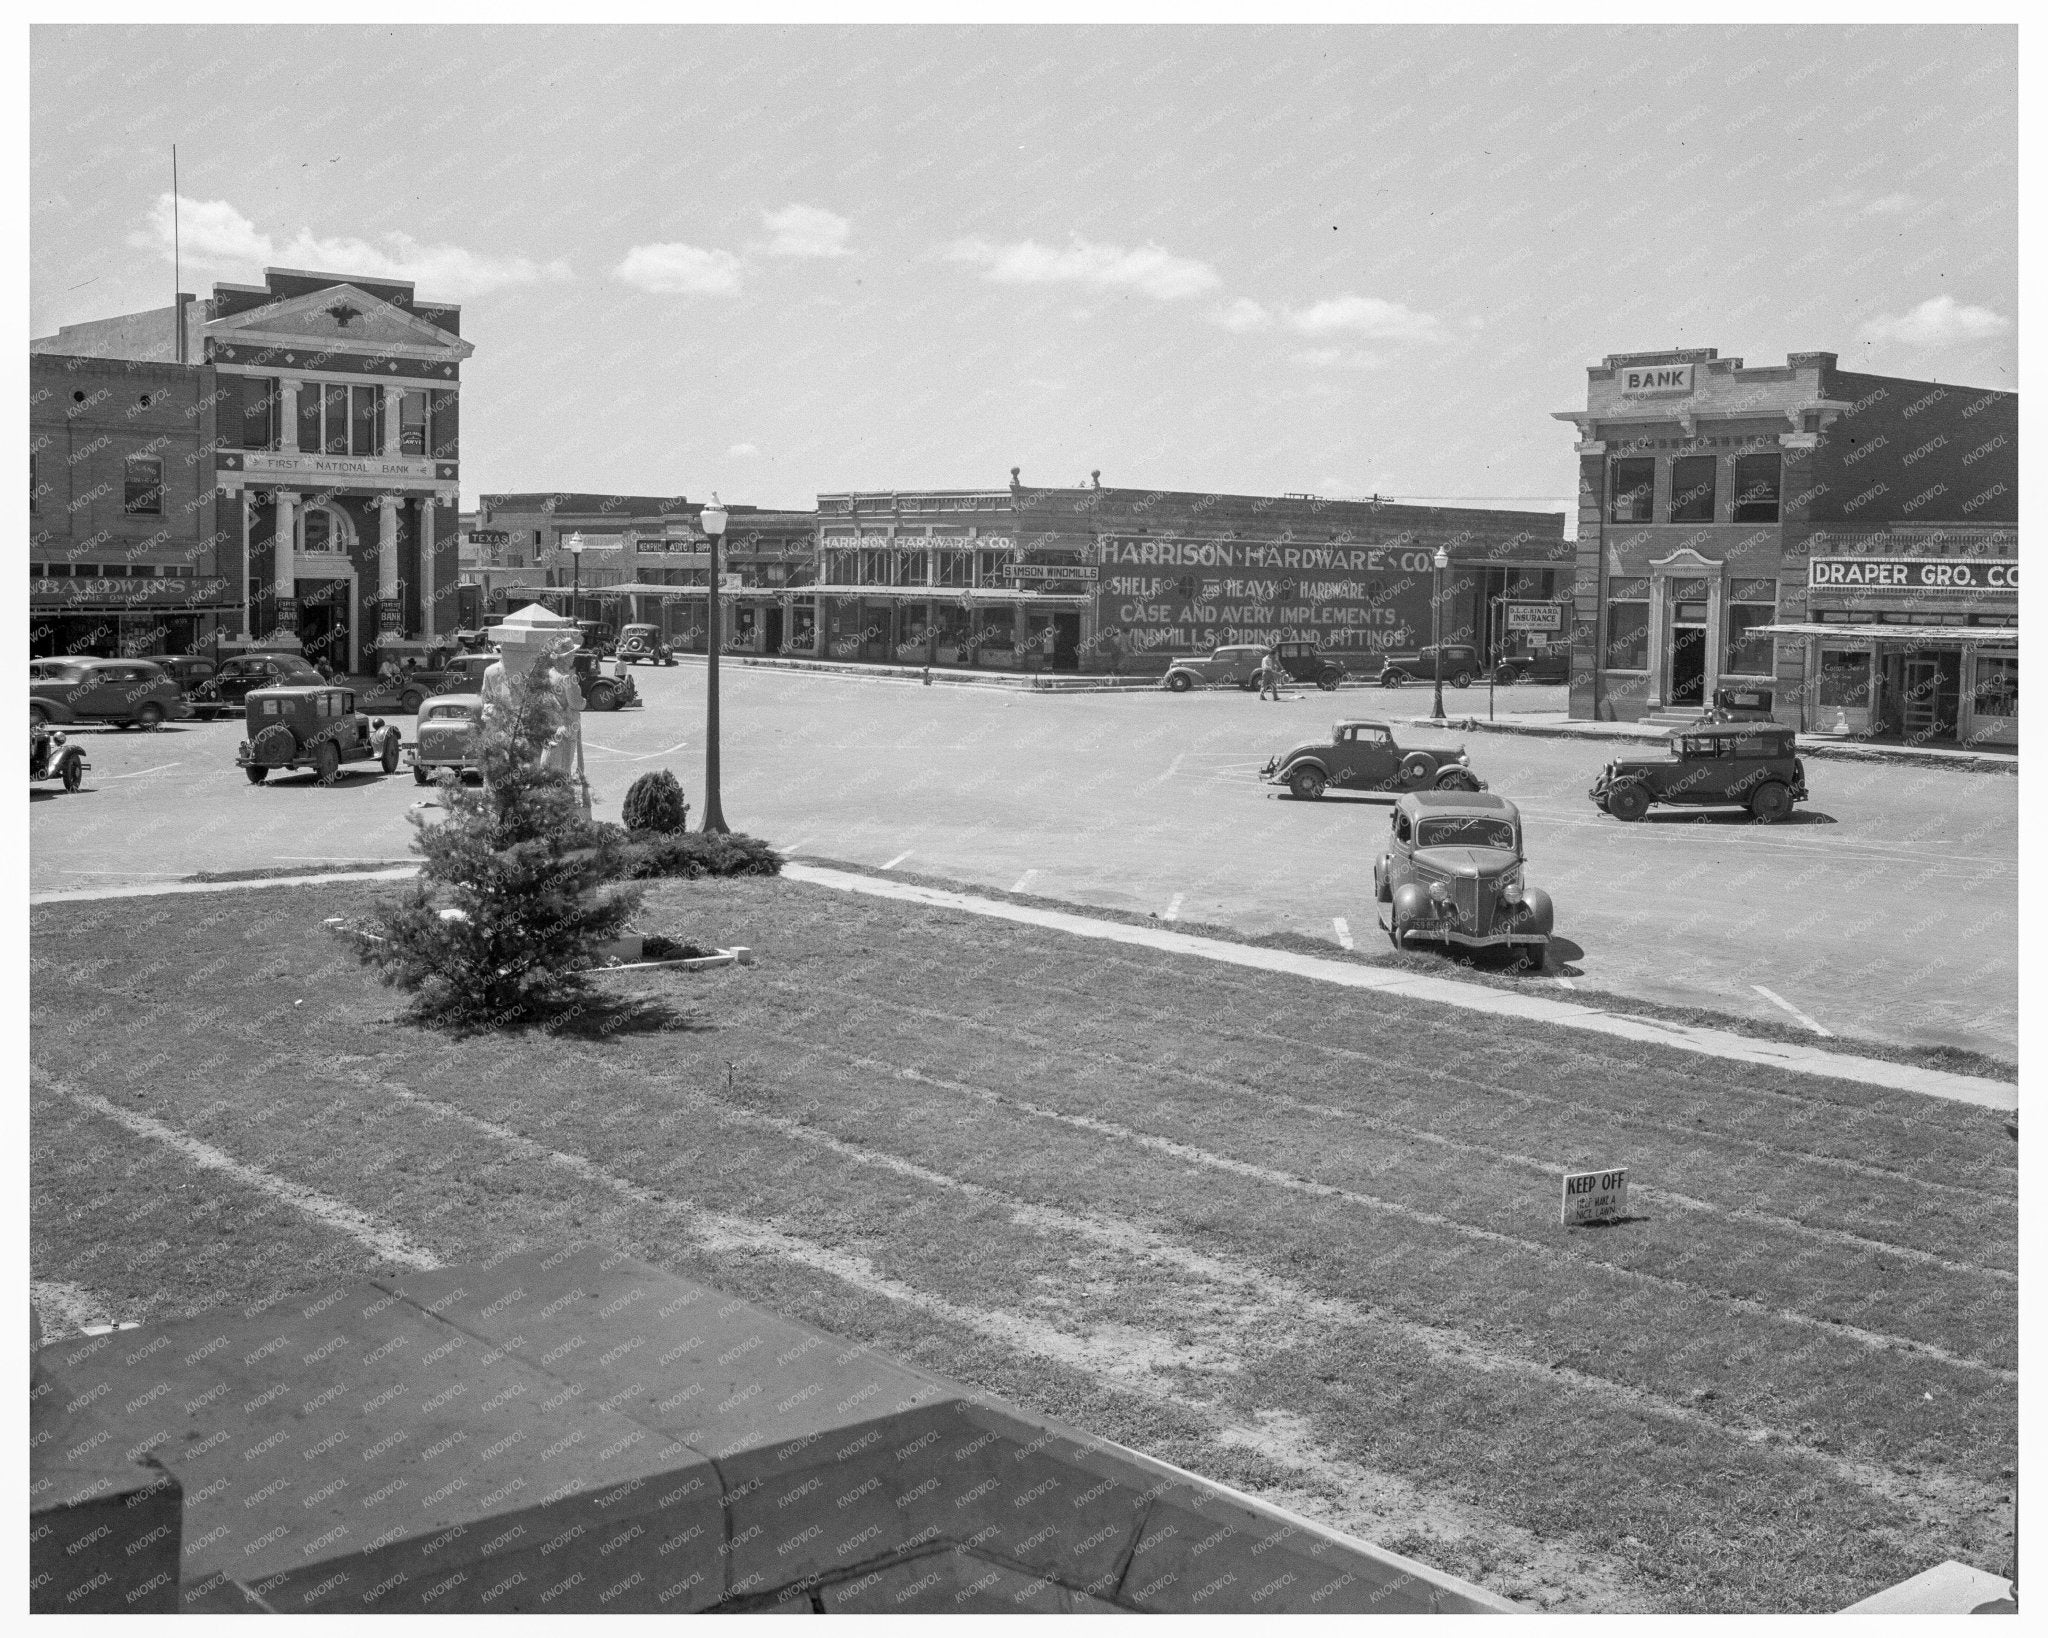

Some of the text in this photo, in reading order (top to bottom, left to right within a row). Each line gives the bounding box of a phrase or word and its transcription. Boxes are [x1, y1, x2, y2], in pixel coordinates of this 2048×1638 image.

[1629, 371, 1684, 388] BANK
[268, 459, 409, 474] FIRST NATIONAL BANK
[472, 533, 509, 544] TEXAS
[821, 537, 1014, 549] HARRISON HARDWARE CO.
[695, 542, 711, 552] SUPP
[1101, 541, 1433, 573] HARRISON HARDWARE CO.
[1004, 566, 1097, 579] SAMSON WINDMILLS
[1816, 563, 1908, 584] DRAPER
[1920, 565, 1977, 586] GRO.
[1112, 577, 1161, 595] SHELF
[1227, 580, 1277, 598] HEAVY
[381, 612, 401, 621] BANK
[1120, 604, 1405, 626] CASE AND AVERY IMPLEMENTS,
[1513, 614, 1556, 622] INSURANCE
[1289, 629, 1321, 643] AND
[1568, 1172, 1625, 1195] KEEP OFF
